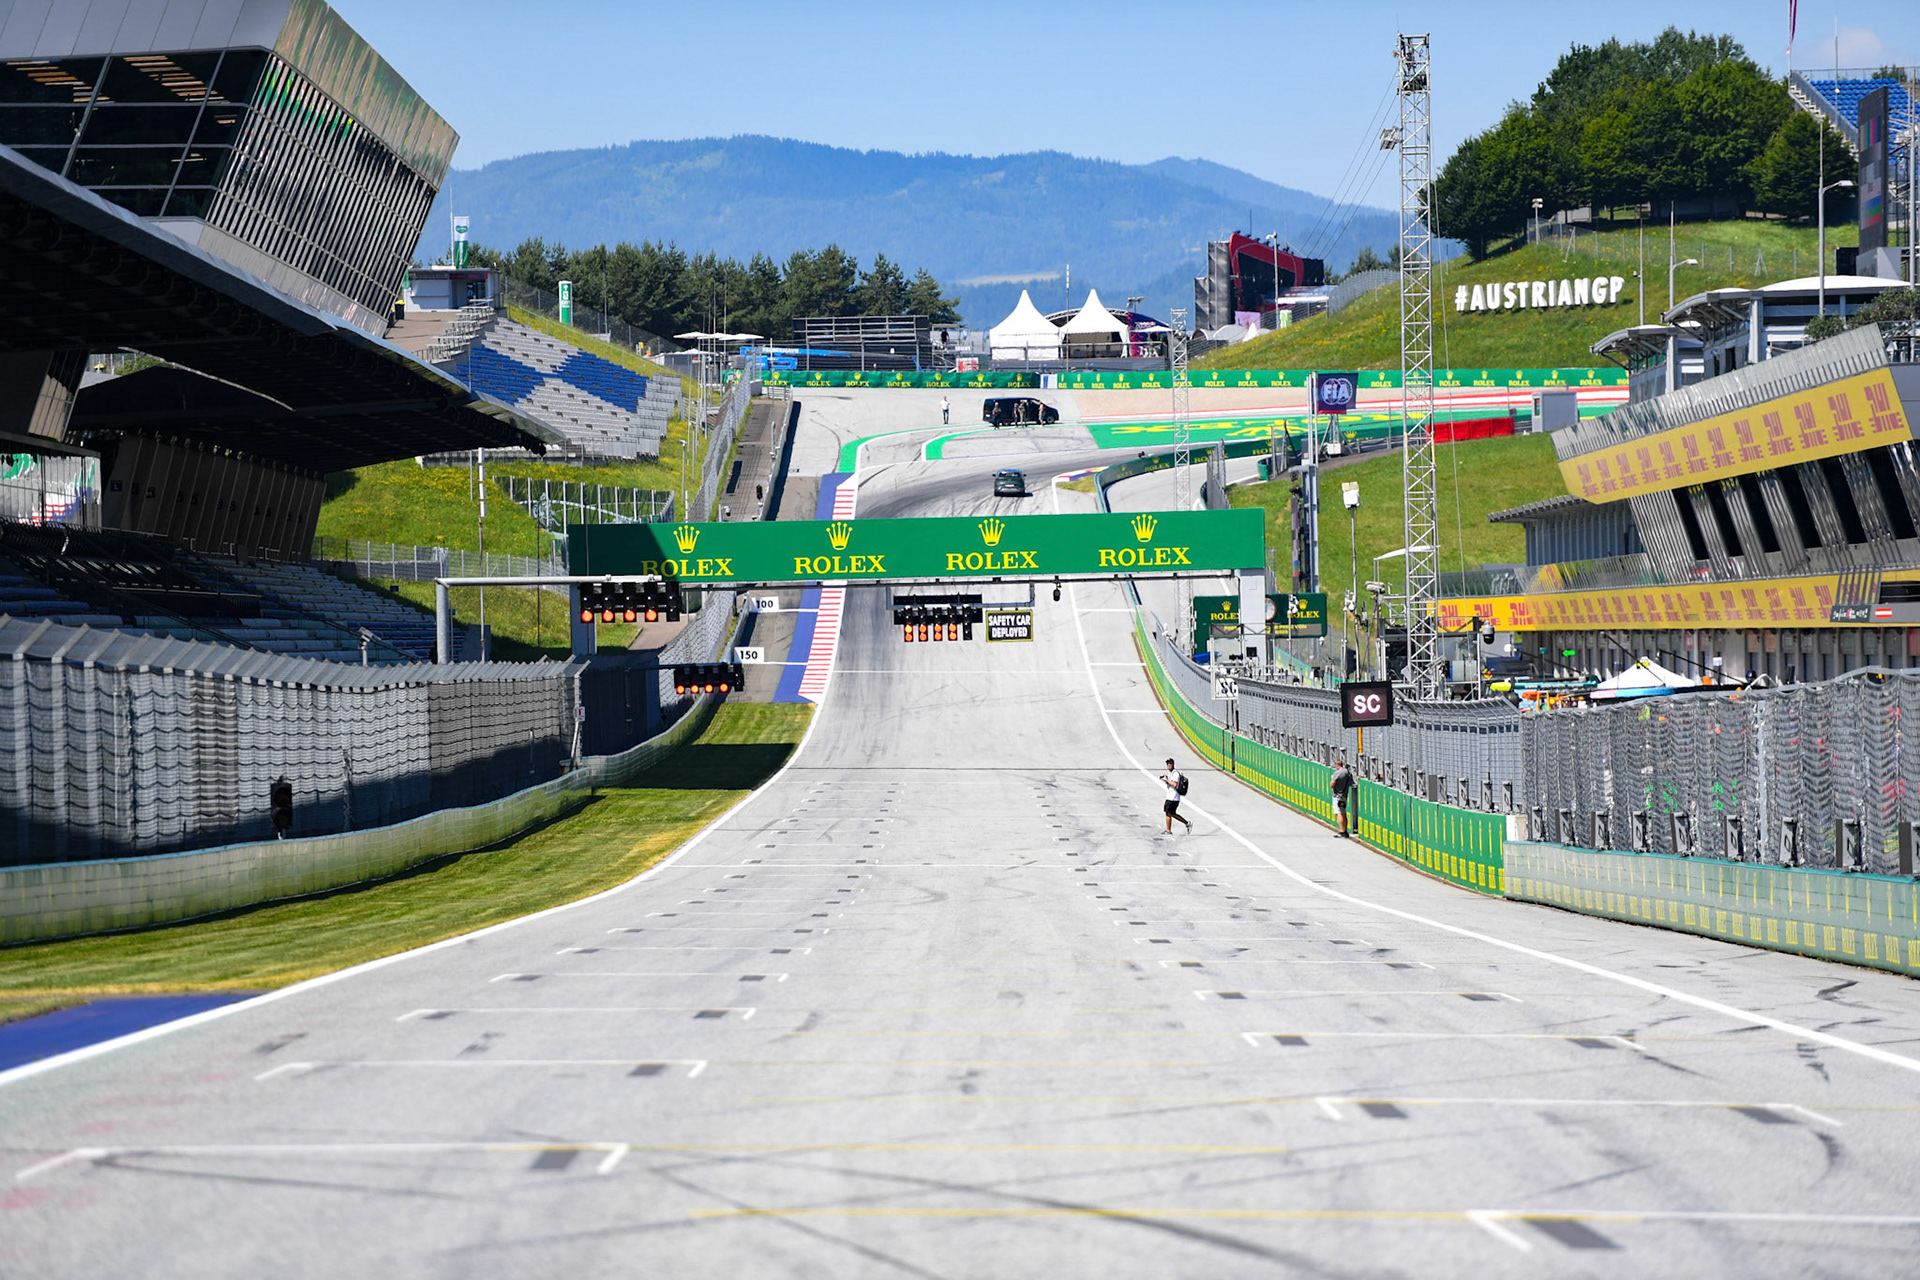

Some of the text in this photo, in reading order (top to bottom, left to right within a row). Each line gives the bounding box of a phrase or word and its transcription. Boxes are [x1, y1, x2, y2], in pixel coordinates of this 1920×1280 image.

[1455, 276, 1625, 311] #AUSTRIANGP
[794, 555, 886, 574] ROLEX
[946, 551, 1039, 571] ROLEX
[1099, 547, 1191, 567] ROLEX
[641, 558, 734, 577] ROLEX
[756, 600, 774, 609] 100
[988, 615, 1031, 626] SAFETY CAR
[1210, 612, 1240, 621] ROLE
[992, 627, 1028, 638] DEPLOYED
[740, 650, 758, 660] 150
[1354, 694, 1381, 714] SC
